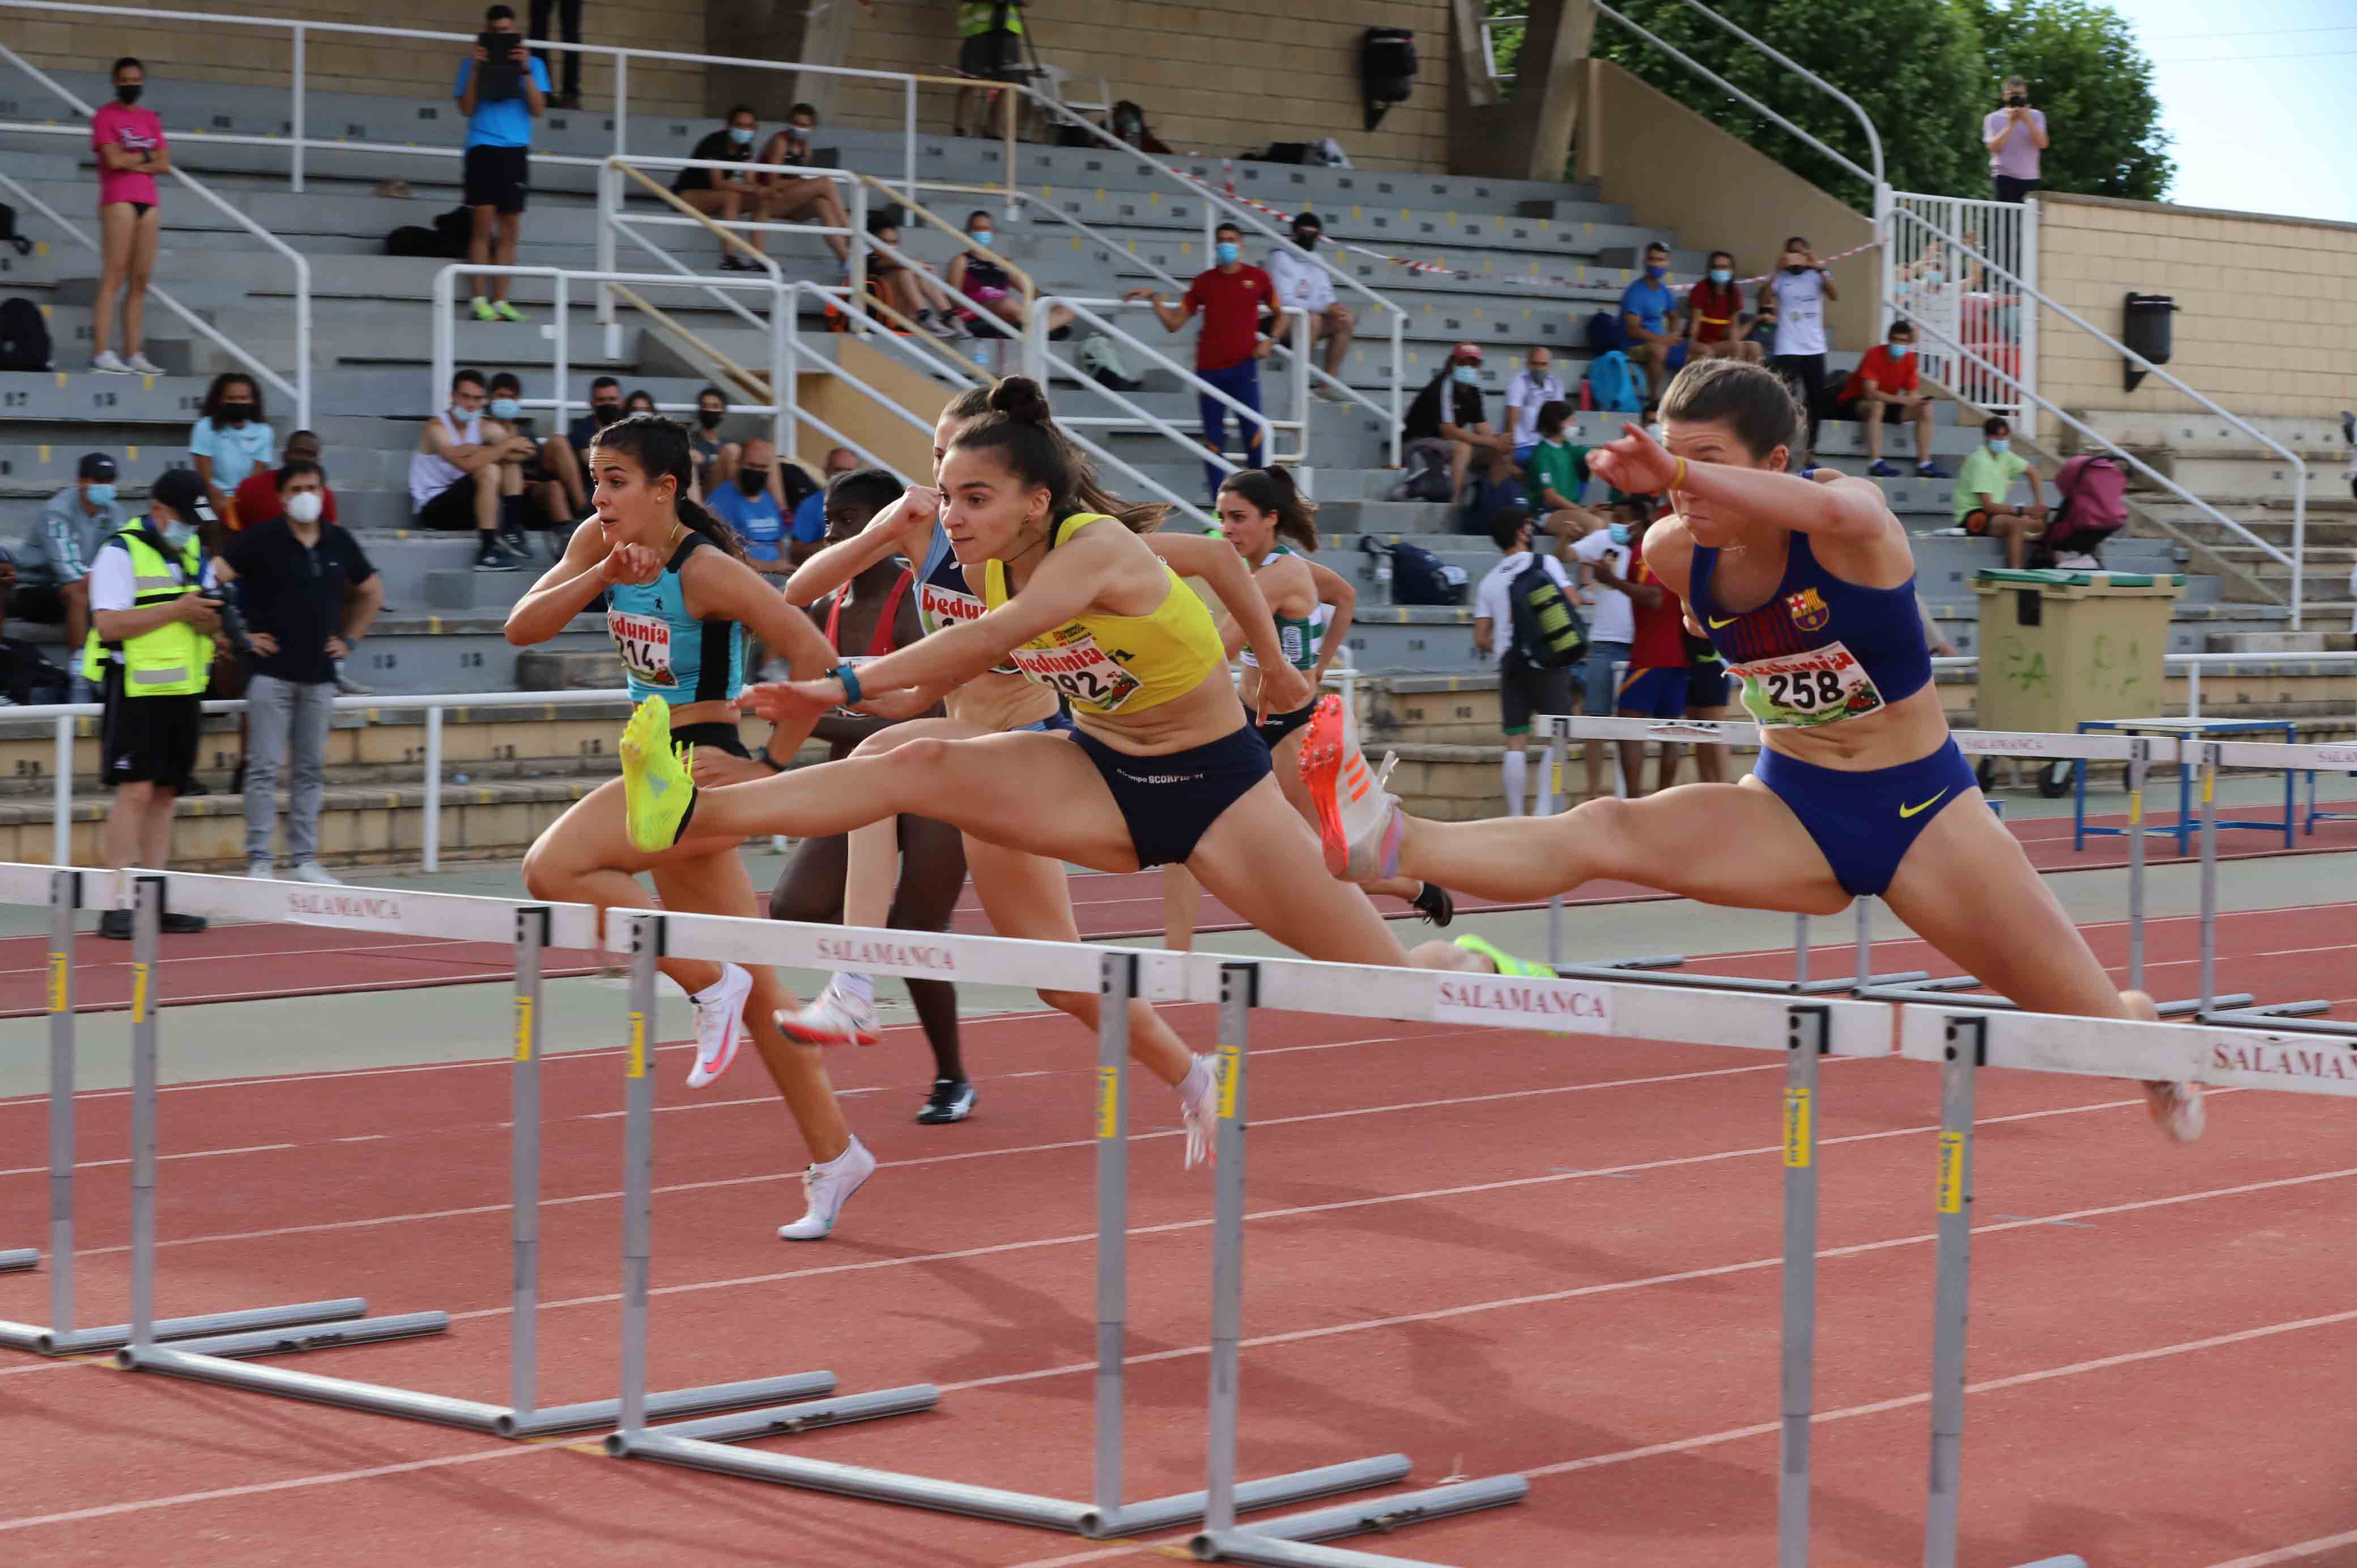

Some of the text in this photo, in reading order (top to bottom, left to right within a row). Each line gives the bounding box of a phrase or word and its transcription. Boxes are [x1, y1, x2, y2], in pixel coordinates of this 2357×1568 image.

[1041, 670, 1111, 699] 292
[1768, 670, 1845, 709] 258
[287, 892, 402, 919] SALAMANCA
[815, 938, 956, 970] SALAMANCA
[1438, 982, 1605, 1018] SALAMANCA
